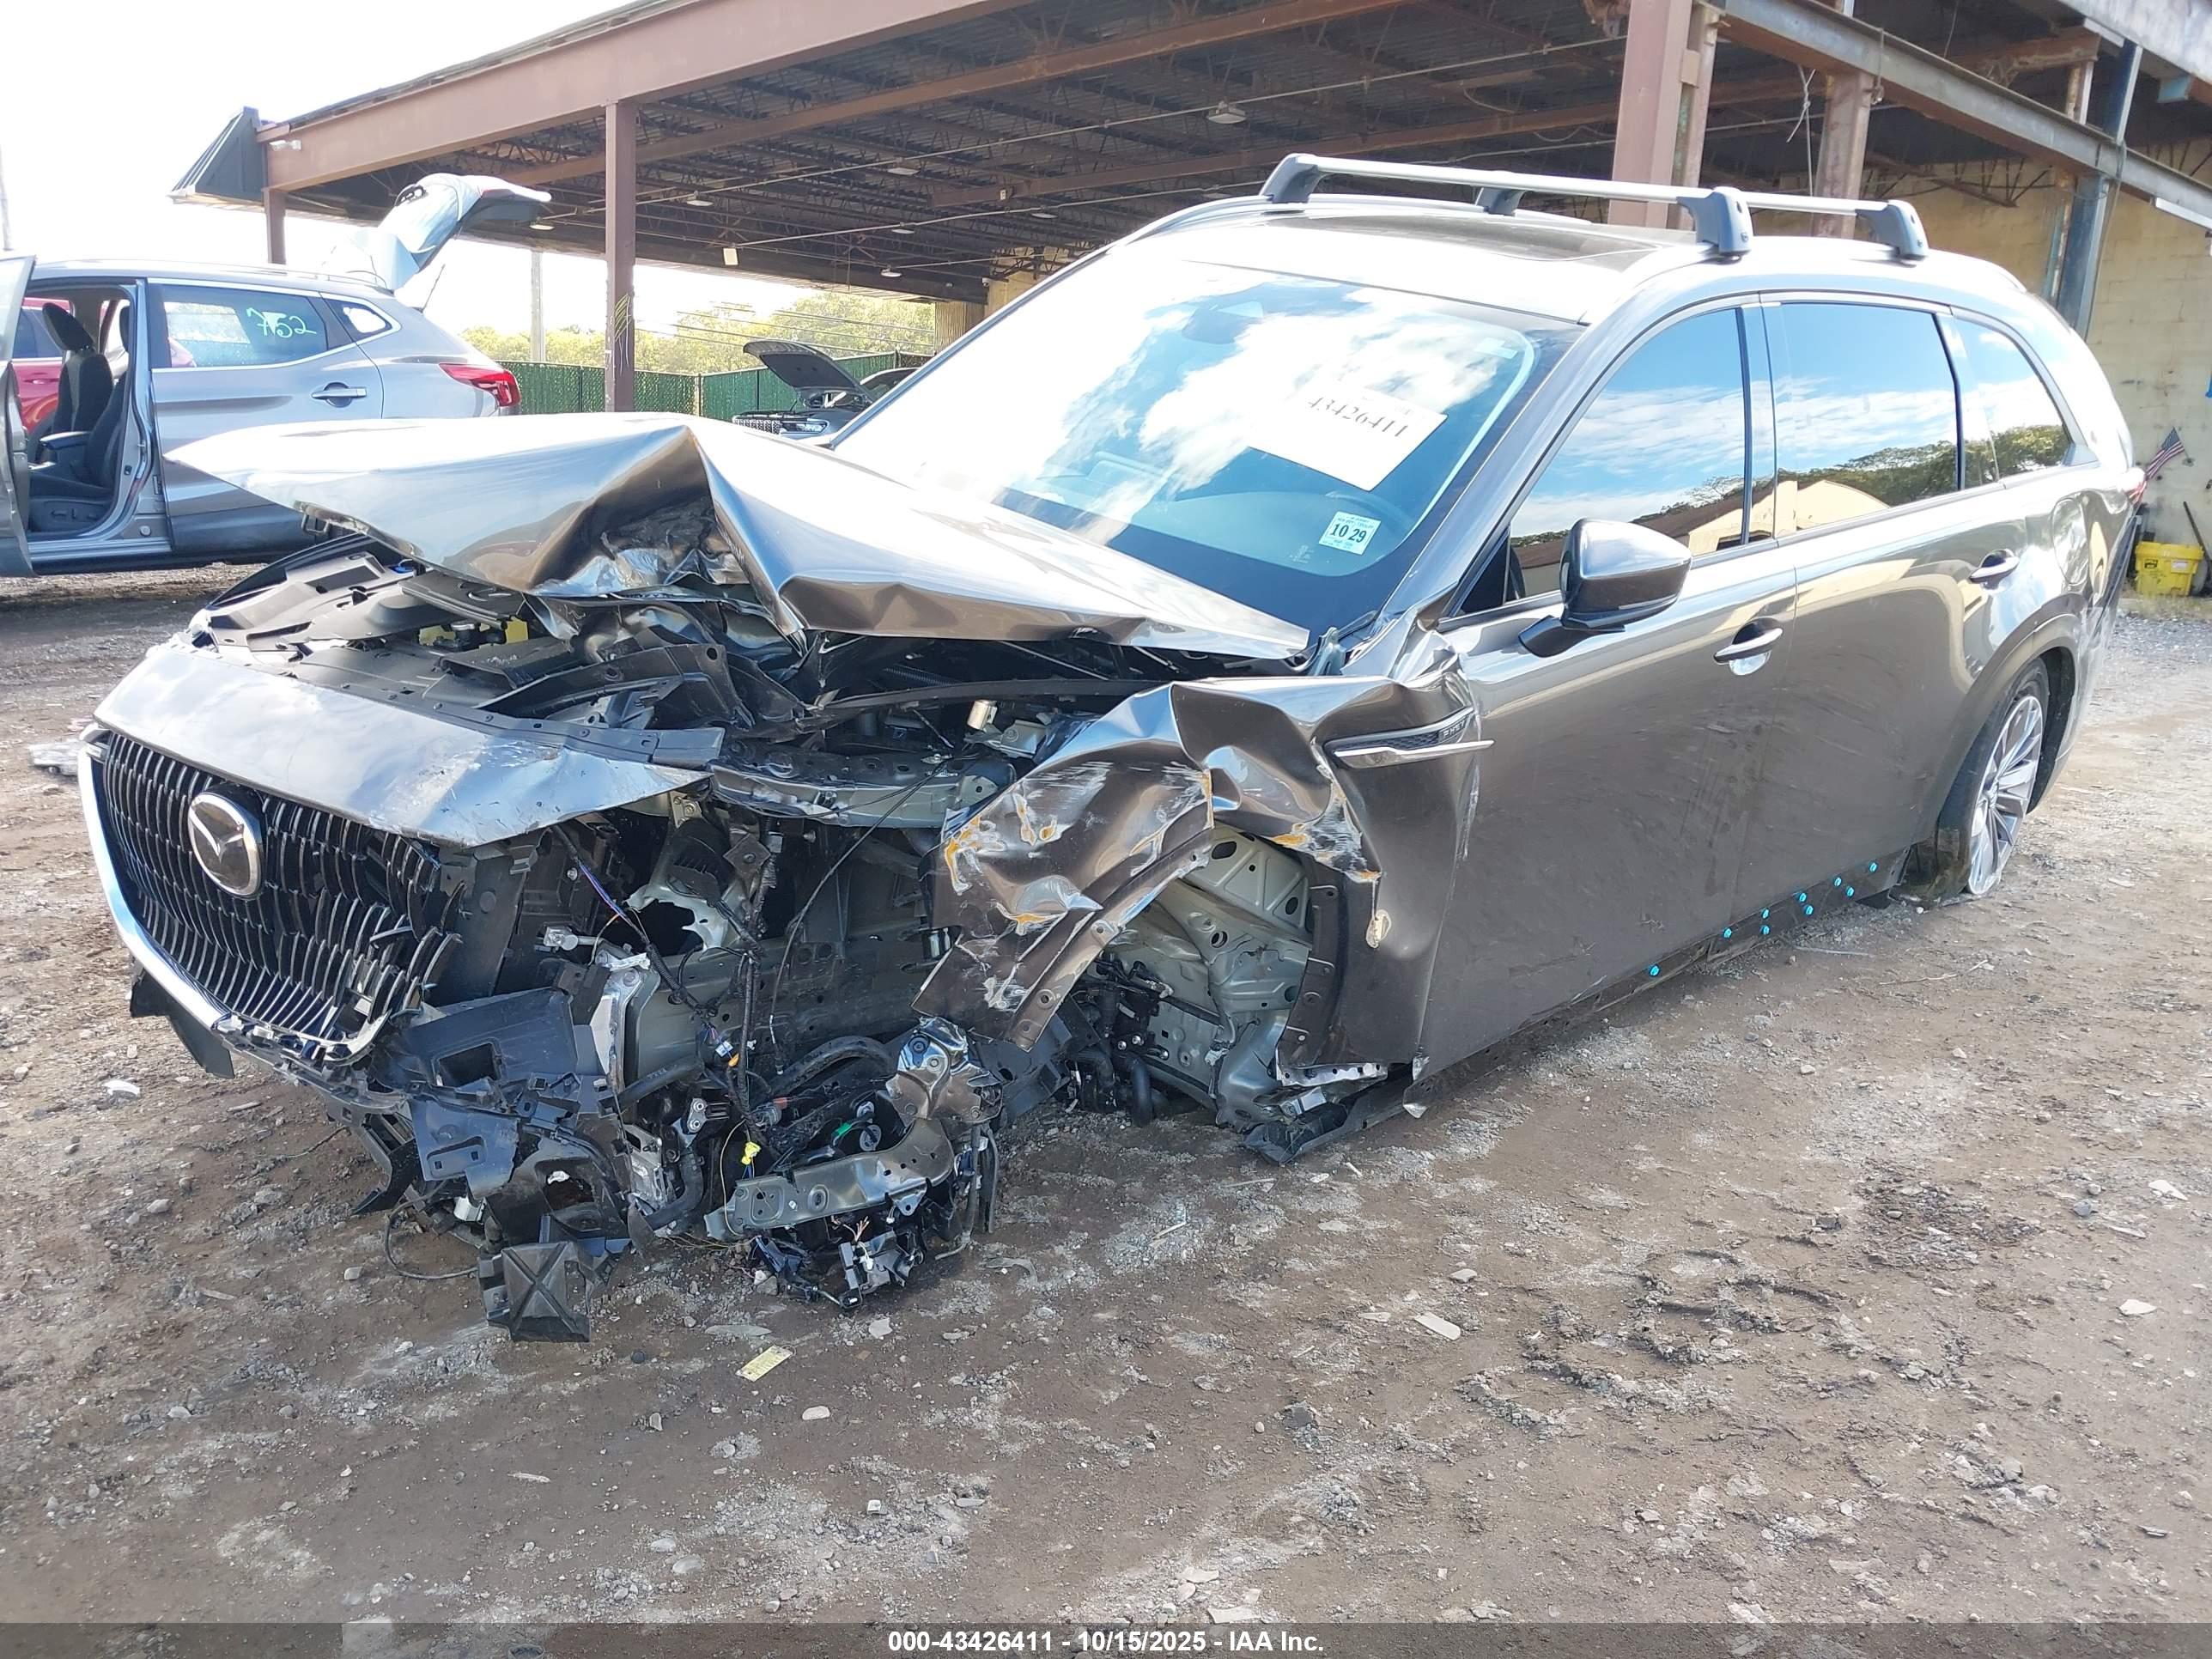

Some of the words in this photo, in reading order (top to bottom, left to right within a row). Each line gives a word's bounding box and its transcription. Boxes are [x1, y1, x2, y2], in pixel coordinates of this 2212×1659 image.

[246, 307, 318, 338] 752
[1329, 523, 1350, 538] 10
[1347, 528, 1367, 544] 29
